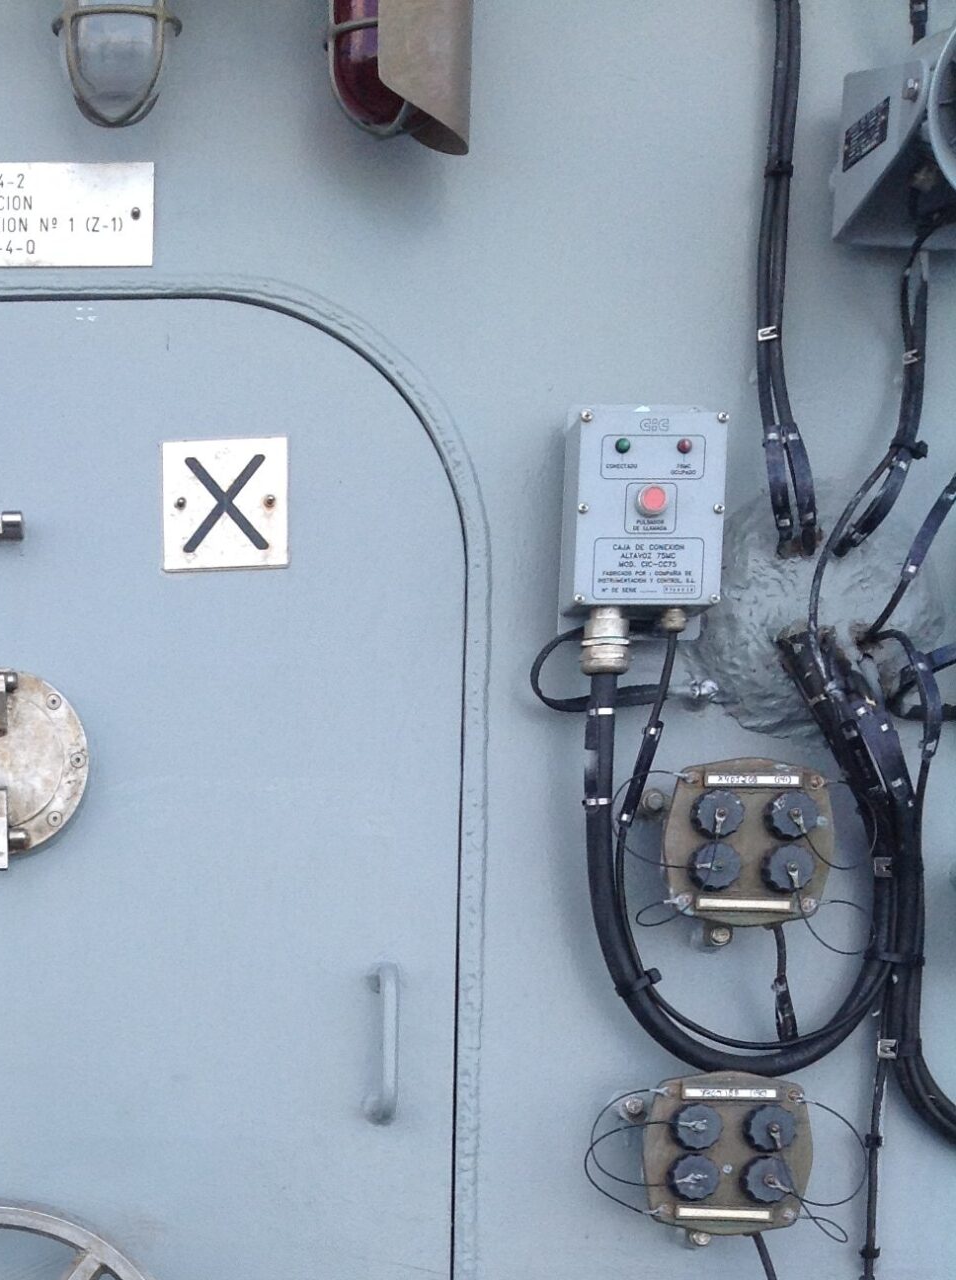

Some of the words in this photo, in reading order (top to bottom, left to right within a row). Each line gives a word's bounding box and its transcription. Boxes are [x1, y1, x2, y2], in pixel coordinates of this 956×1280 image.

[68, 217, 75, 232] 1
[85, 216, 124, 233] (Z-1)
[182, 453, 270, 554] X
[612, 543, 631, 551] CAJA
[635, 543, 645, 551] DE
[648, 543, 685, 551] CONEXION
